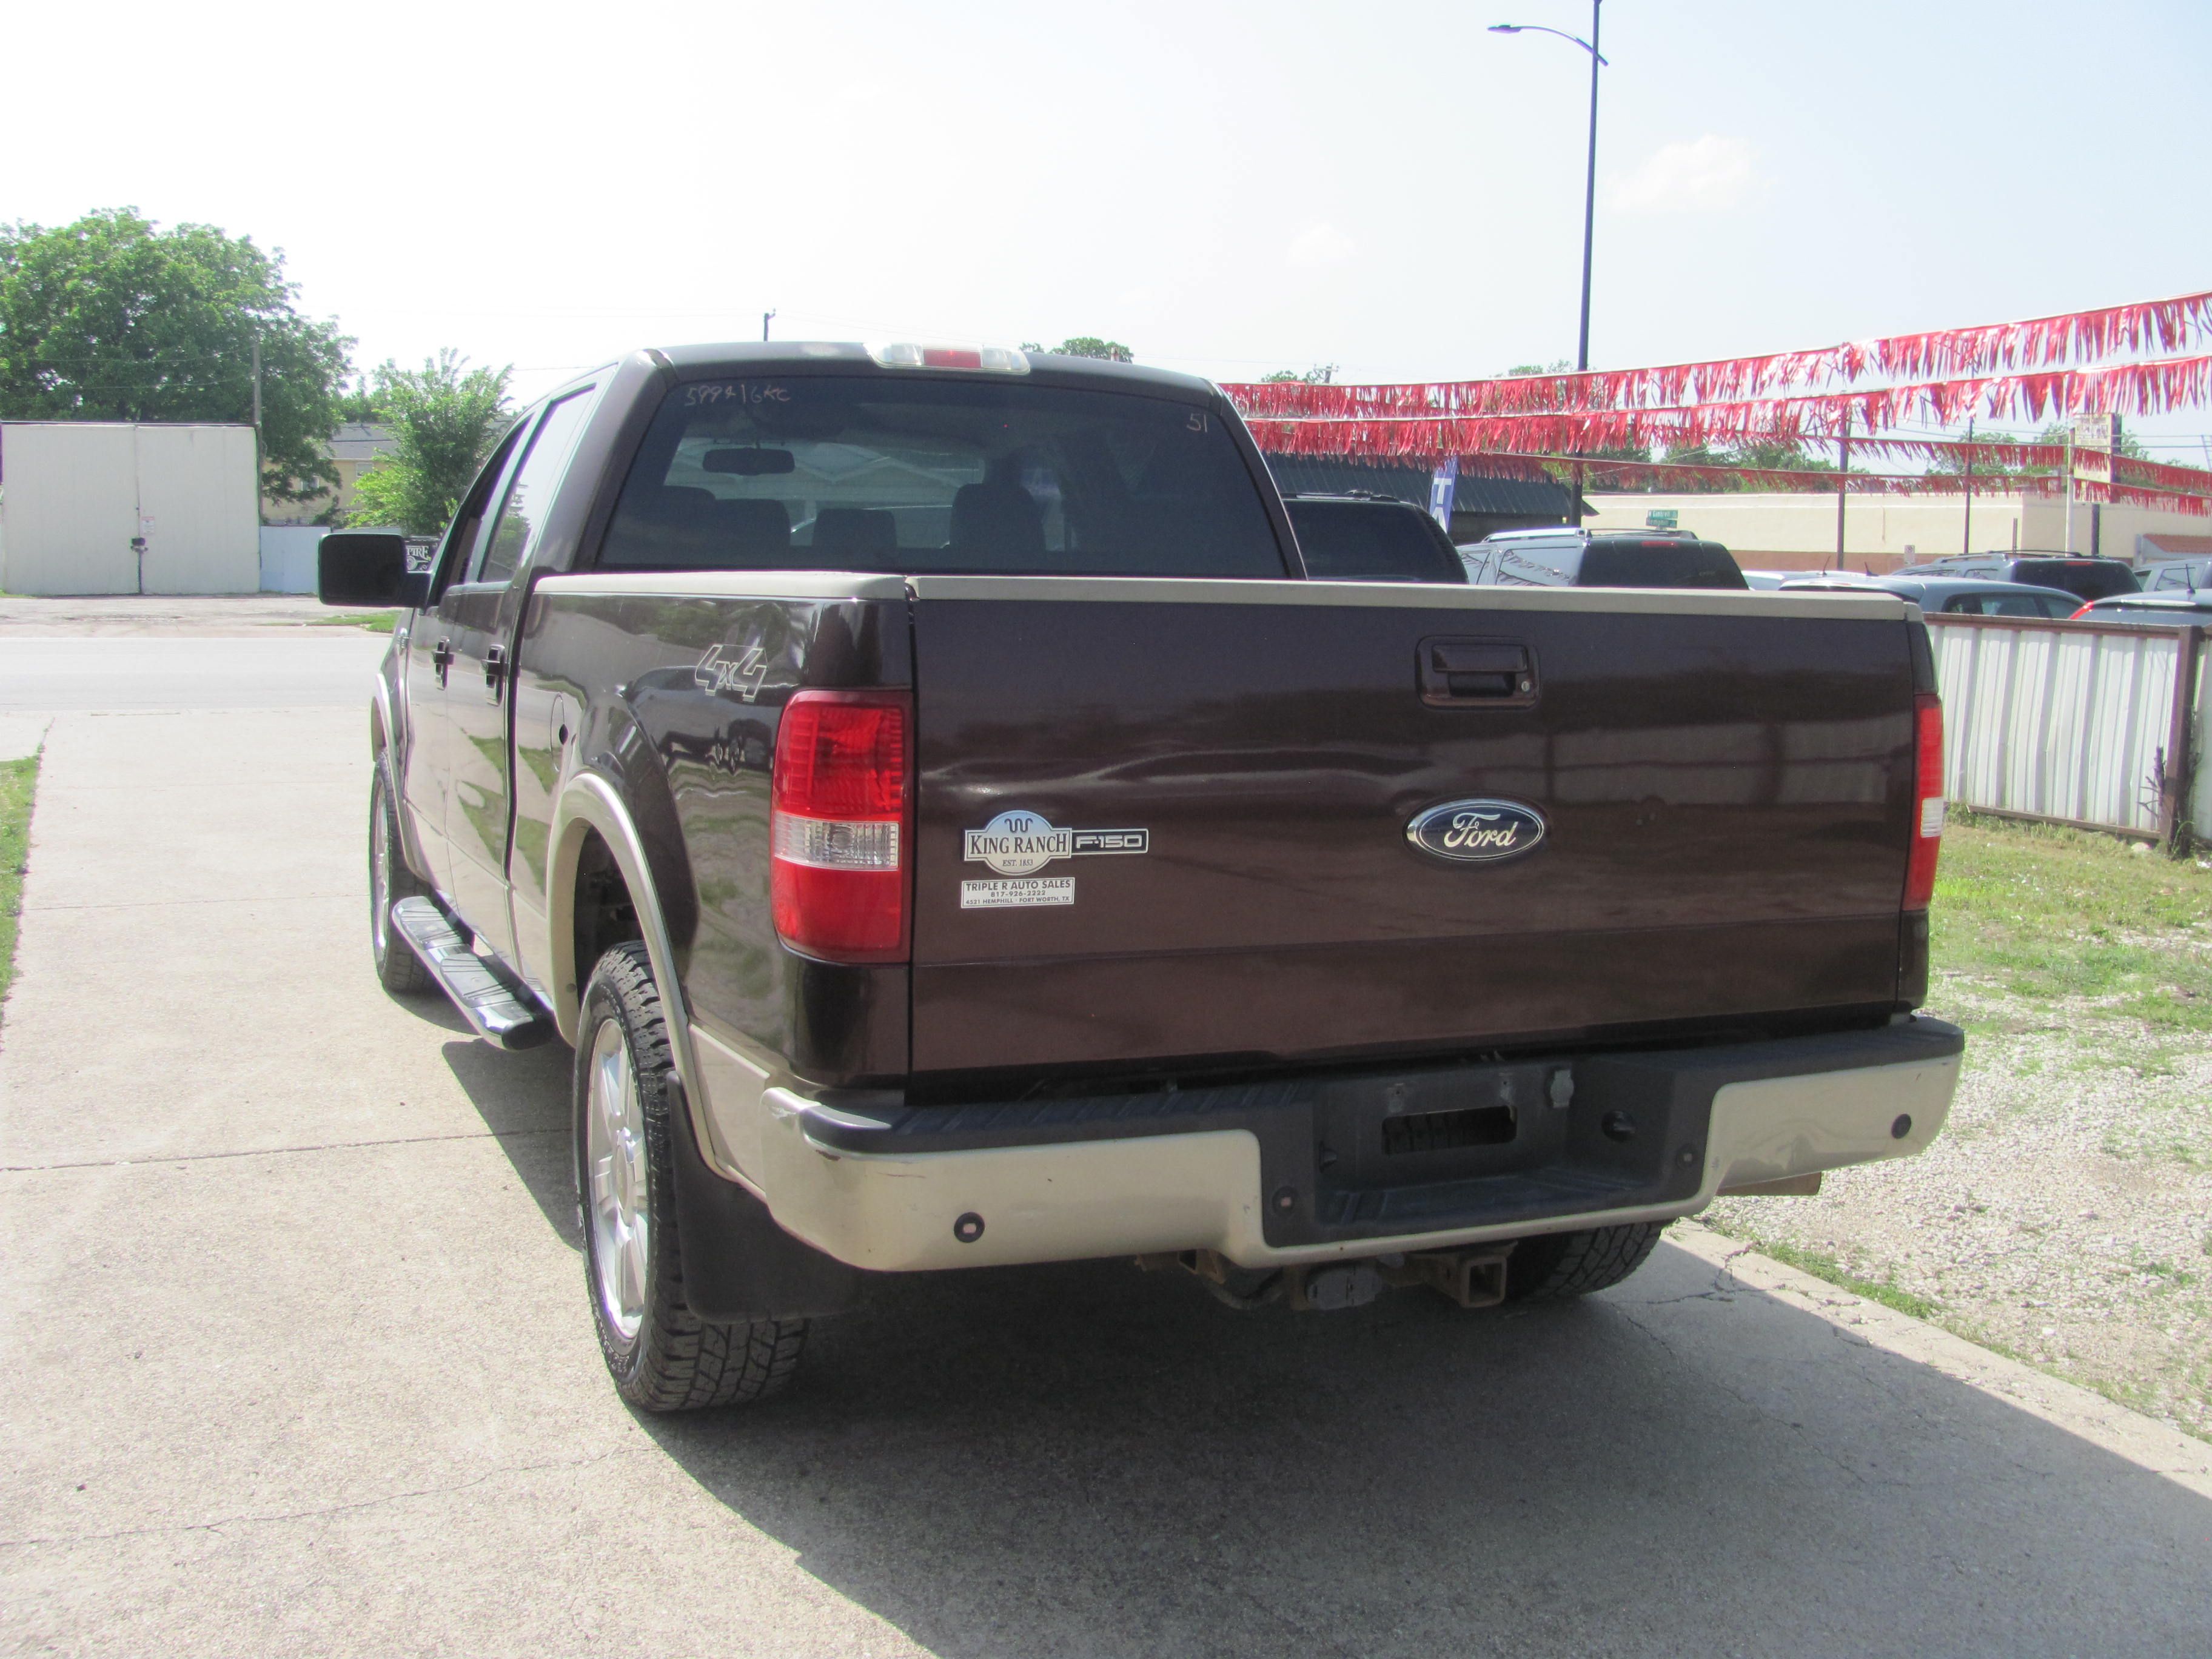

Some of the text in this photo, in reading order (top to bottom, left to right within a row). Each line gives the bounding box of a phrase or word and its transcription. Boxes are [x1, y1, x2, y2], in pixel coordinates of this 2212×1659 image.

[1432, 477, 1452, 534] TA
[971, 833, 1067, 854] KING RANCH
[1444, 812, 1518, 848] Ford
[966, 882, 998, 891] TRIPLE
[1011, 881, 1038, 890] AUTO
[1042, 880, 1070, 888] SALES
